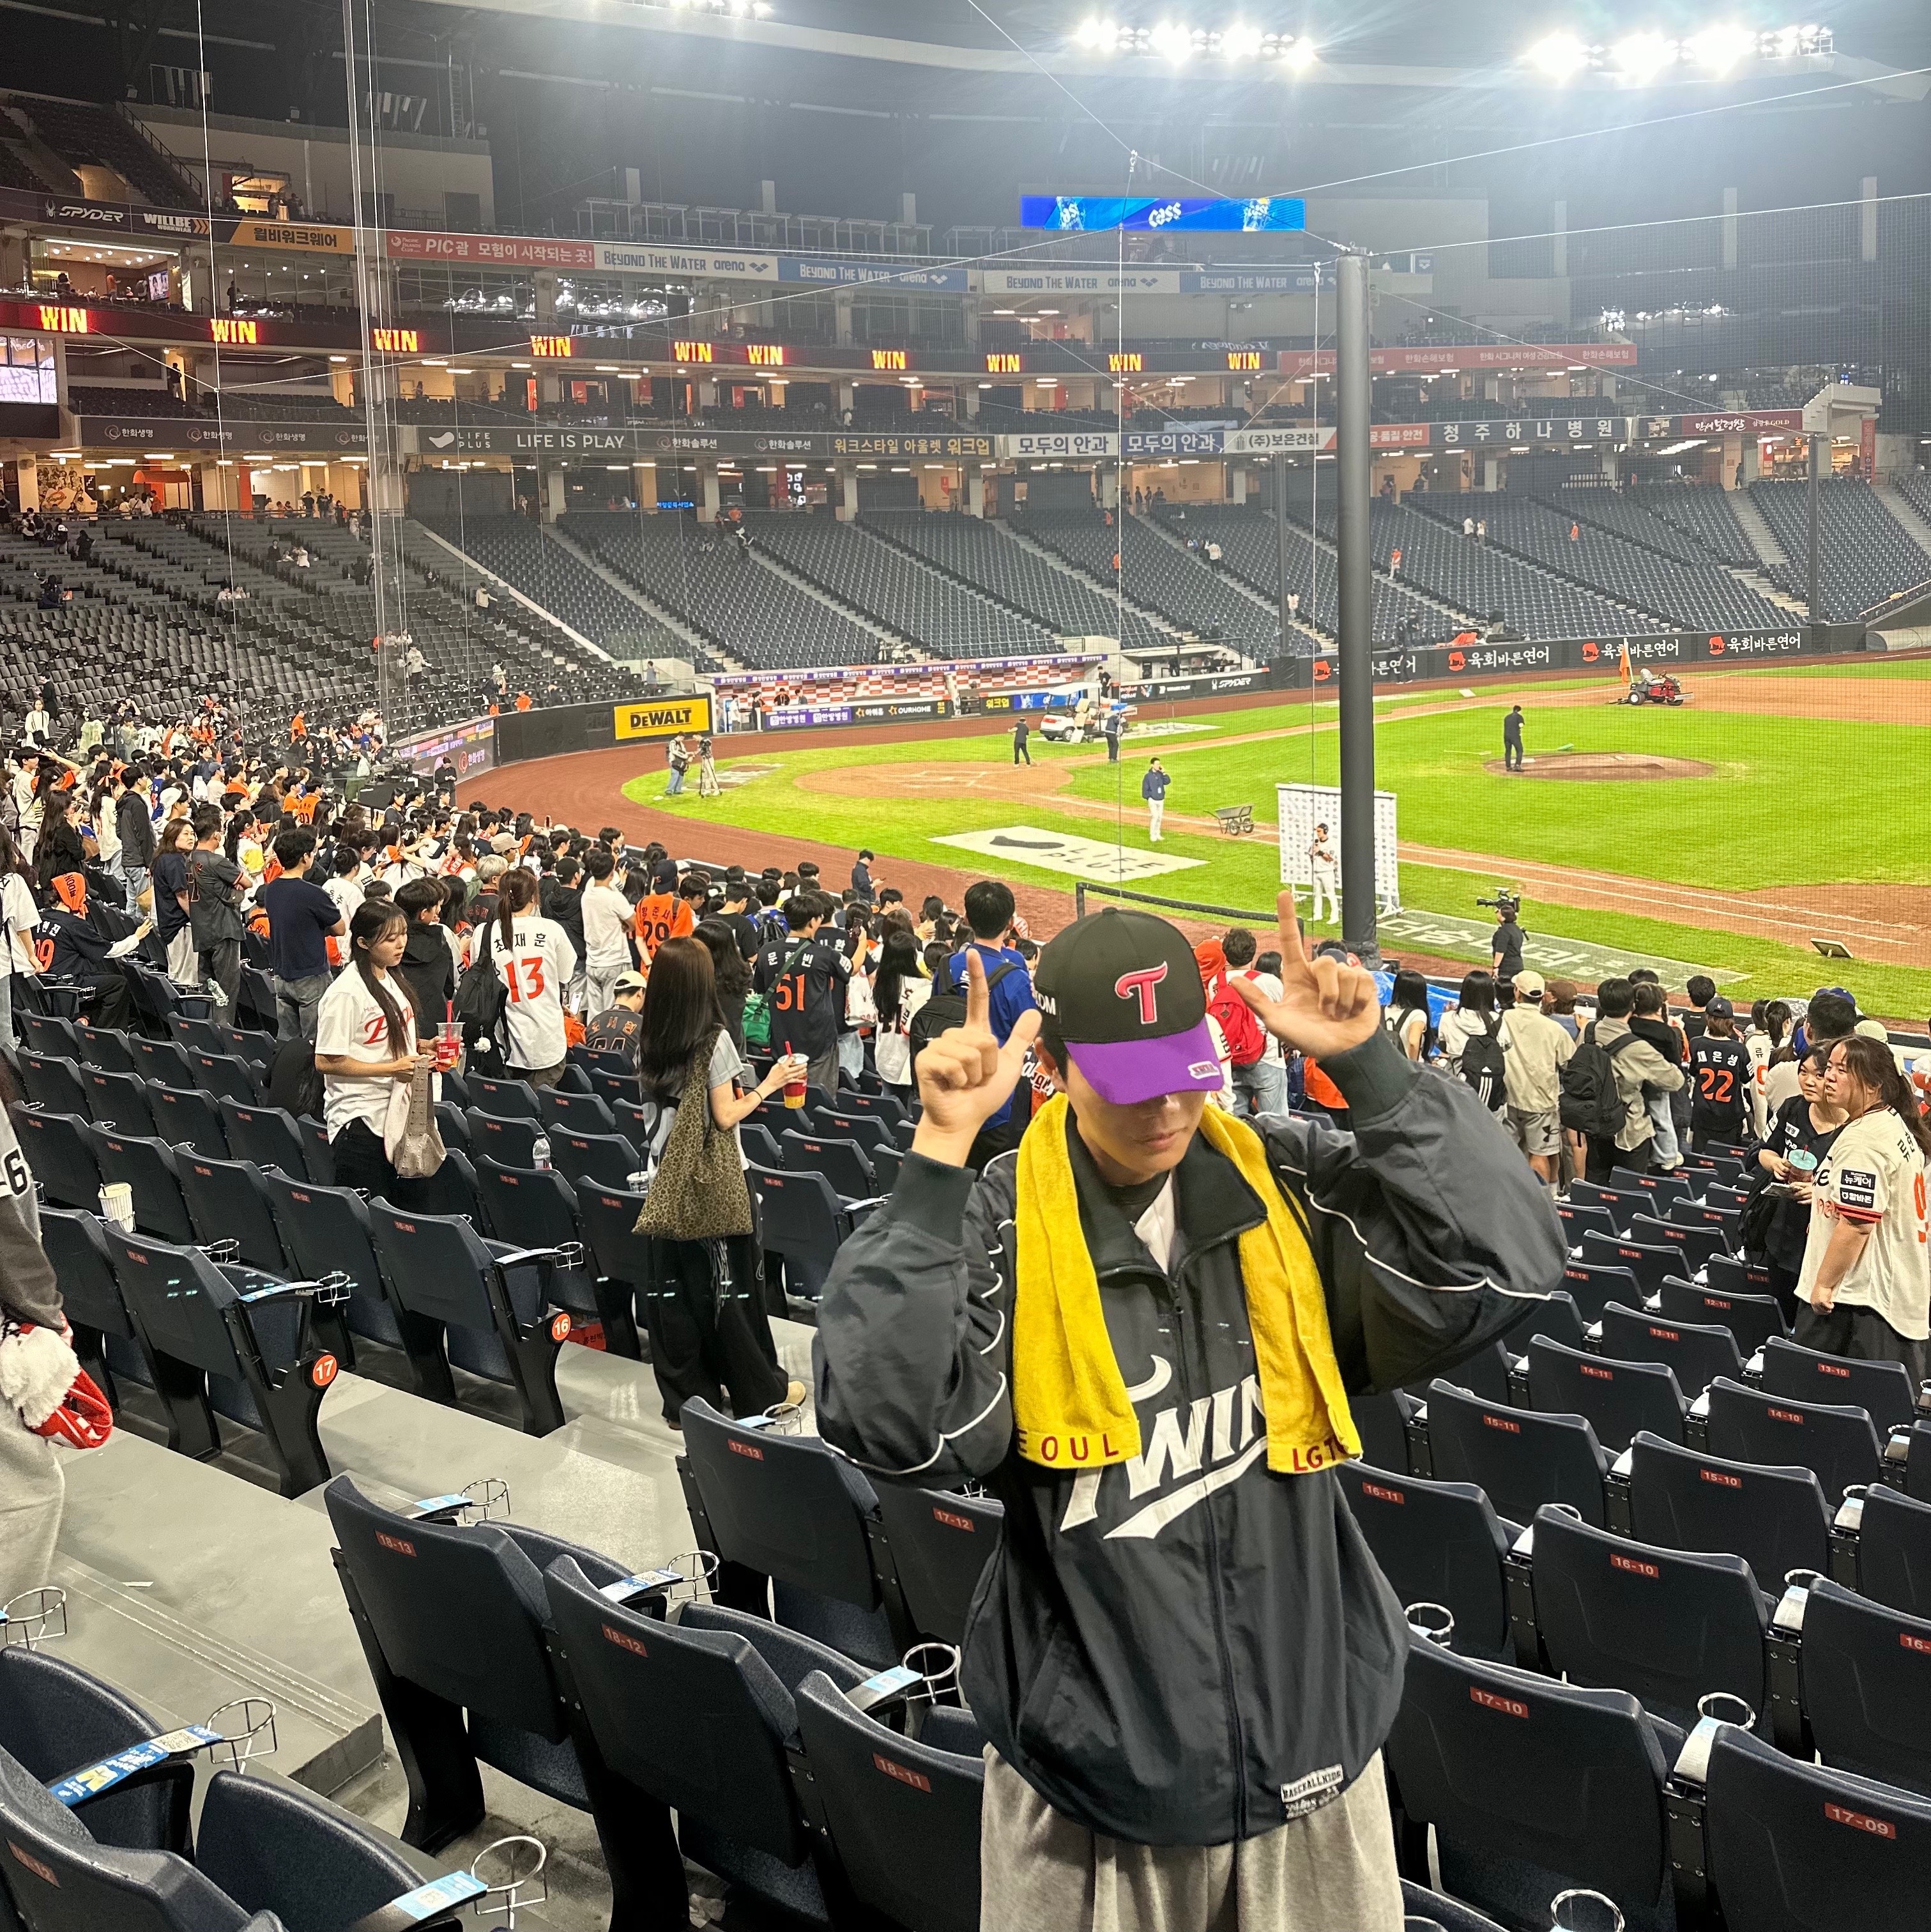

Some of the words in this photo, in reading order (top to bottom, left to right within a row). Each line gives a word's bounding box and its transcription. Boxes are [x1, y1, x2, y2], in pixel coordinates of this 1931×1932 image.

[59, 206, 124, 222] SPYDER
[143, 213, 192, 227] WILLBE
[254, 227, 337, 247] 월비워크웨어
[478, 243, 517, 259] 모험이
[521, 245, 572, 262] 시작되는
[575, 249, 593, 263] 곳!
[714, 259, 745, 272] arena
[1108, 277, 1136, 288] arena
[39, 305, 88, 334] WIN
[210, 319, 257, 344] WIN
[374, 328, 418, 352] WIN
[531, 335, 571, 357] WIN
[675, 341, 712, 363] WIN
[747, 344, 784, 366] WIN
[872, 349, 906, 370] WIN
[986, 353, 1020, 373] WIN
[1108, 353, 1141, 372] WIN
[1228, 352, 1260, 370] WIN
[121, 429, 153, 438] 한화생명
[276, 433, 306, 442] 한화생명
[517, 434, 554, 448] LIFE
[561, 434, 576, 448] IS
[583, 435, 625, 448] PLAY
[672, 438, 717, 448] 한화솔루션
[768, 439, 811, 450] 한화솔루션
[834, 438, 899, 454] 워크스타일
[904, 439, 941, 454] 아울렛
[947, 438, 989, 456] 워크업
[1727, 632, 1801, 654] 육회바른연어
[1469, 647, 1550, 670] 육회바른연어
[1219, 677, 1251, 689] SPYDER
[898, 705, 931, 714] OURHOME
[986, 696, 1010, 710] 워크업
[468, 748, 485, 766] 한화생명
[1041, 852, 1134, 875] PLUS
[1070, 847, 1166, 870] LIFE
[642, 920, 670, 947] 29
[505, 956, 544, 1003] 13
[775, 974, 805, 1011] 51
[1115, 961, 1168, 1025] T
[1699, 1068, 1734, 1103] 22
[1844, 1174, 1872, 1188] 뉴케어
[1849, 1192, 1872, 1204] 알바몬
[1566, 1271, 1587, 1279] 12-12
[1707, 1300, 1727, 1308] 12-11
[555, 1321, 569, 1336] 16
[1652, 1330, 1675, 1339] 13-11
[316, 1361, 333, 1381] 17
[1584, 1367, 1608, 1379] 14-11
[1821, 1365, 1846, 1376] 13-10
[1487, 1418, 1515, 1431] 15-11
[1771, 1410, 1800, 1422] 14-10
[731, 1443, 759, 1458] 17-13
[1704, 1472, 1737, 1486] 15-10
[1367, 1484, 1398, 1501] 16-11
[937, 1511, 969, 1529] 17-12
[379, 1535, 411, 1554] 18-13
[1615, 1558, 1654, 1575] 16-10
[605, 1627, 642, 1653] 18-12
[1476, 1692, 1523, 1715] 17-10
[880, 1759, 922, 1786] 18-11
[1832, 1807, 1889, 1835] 17-09
